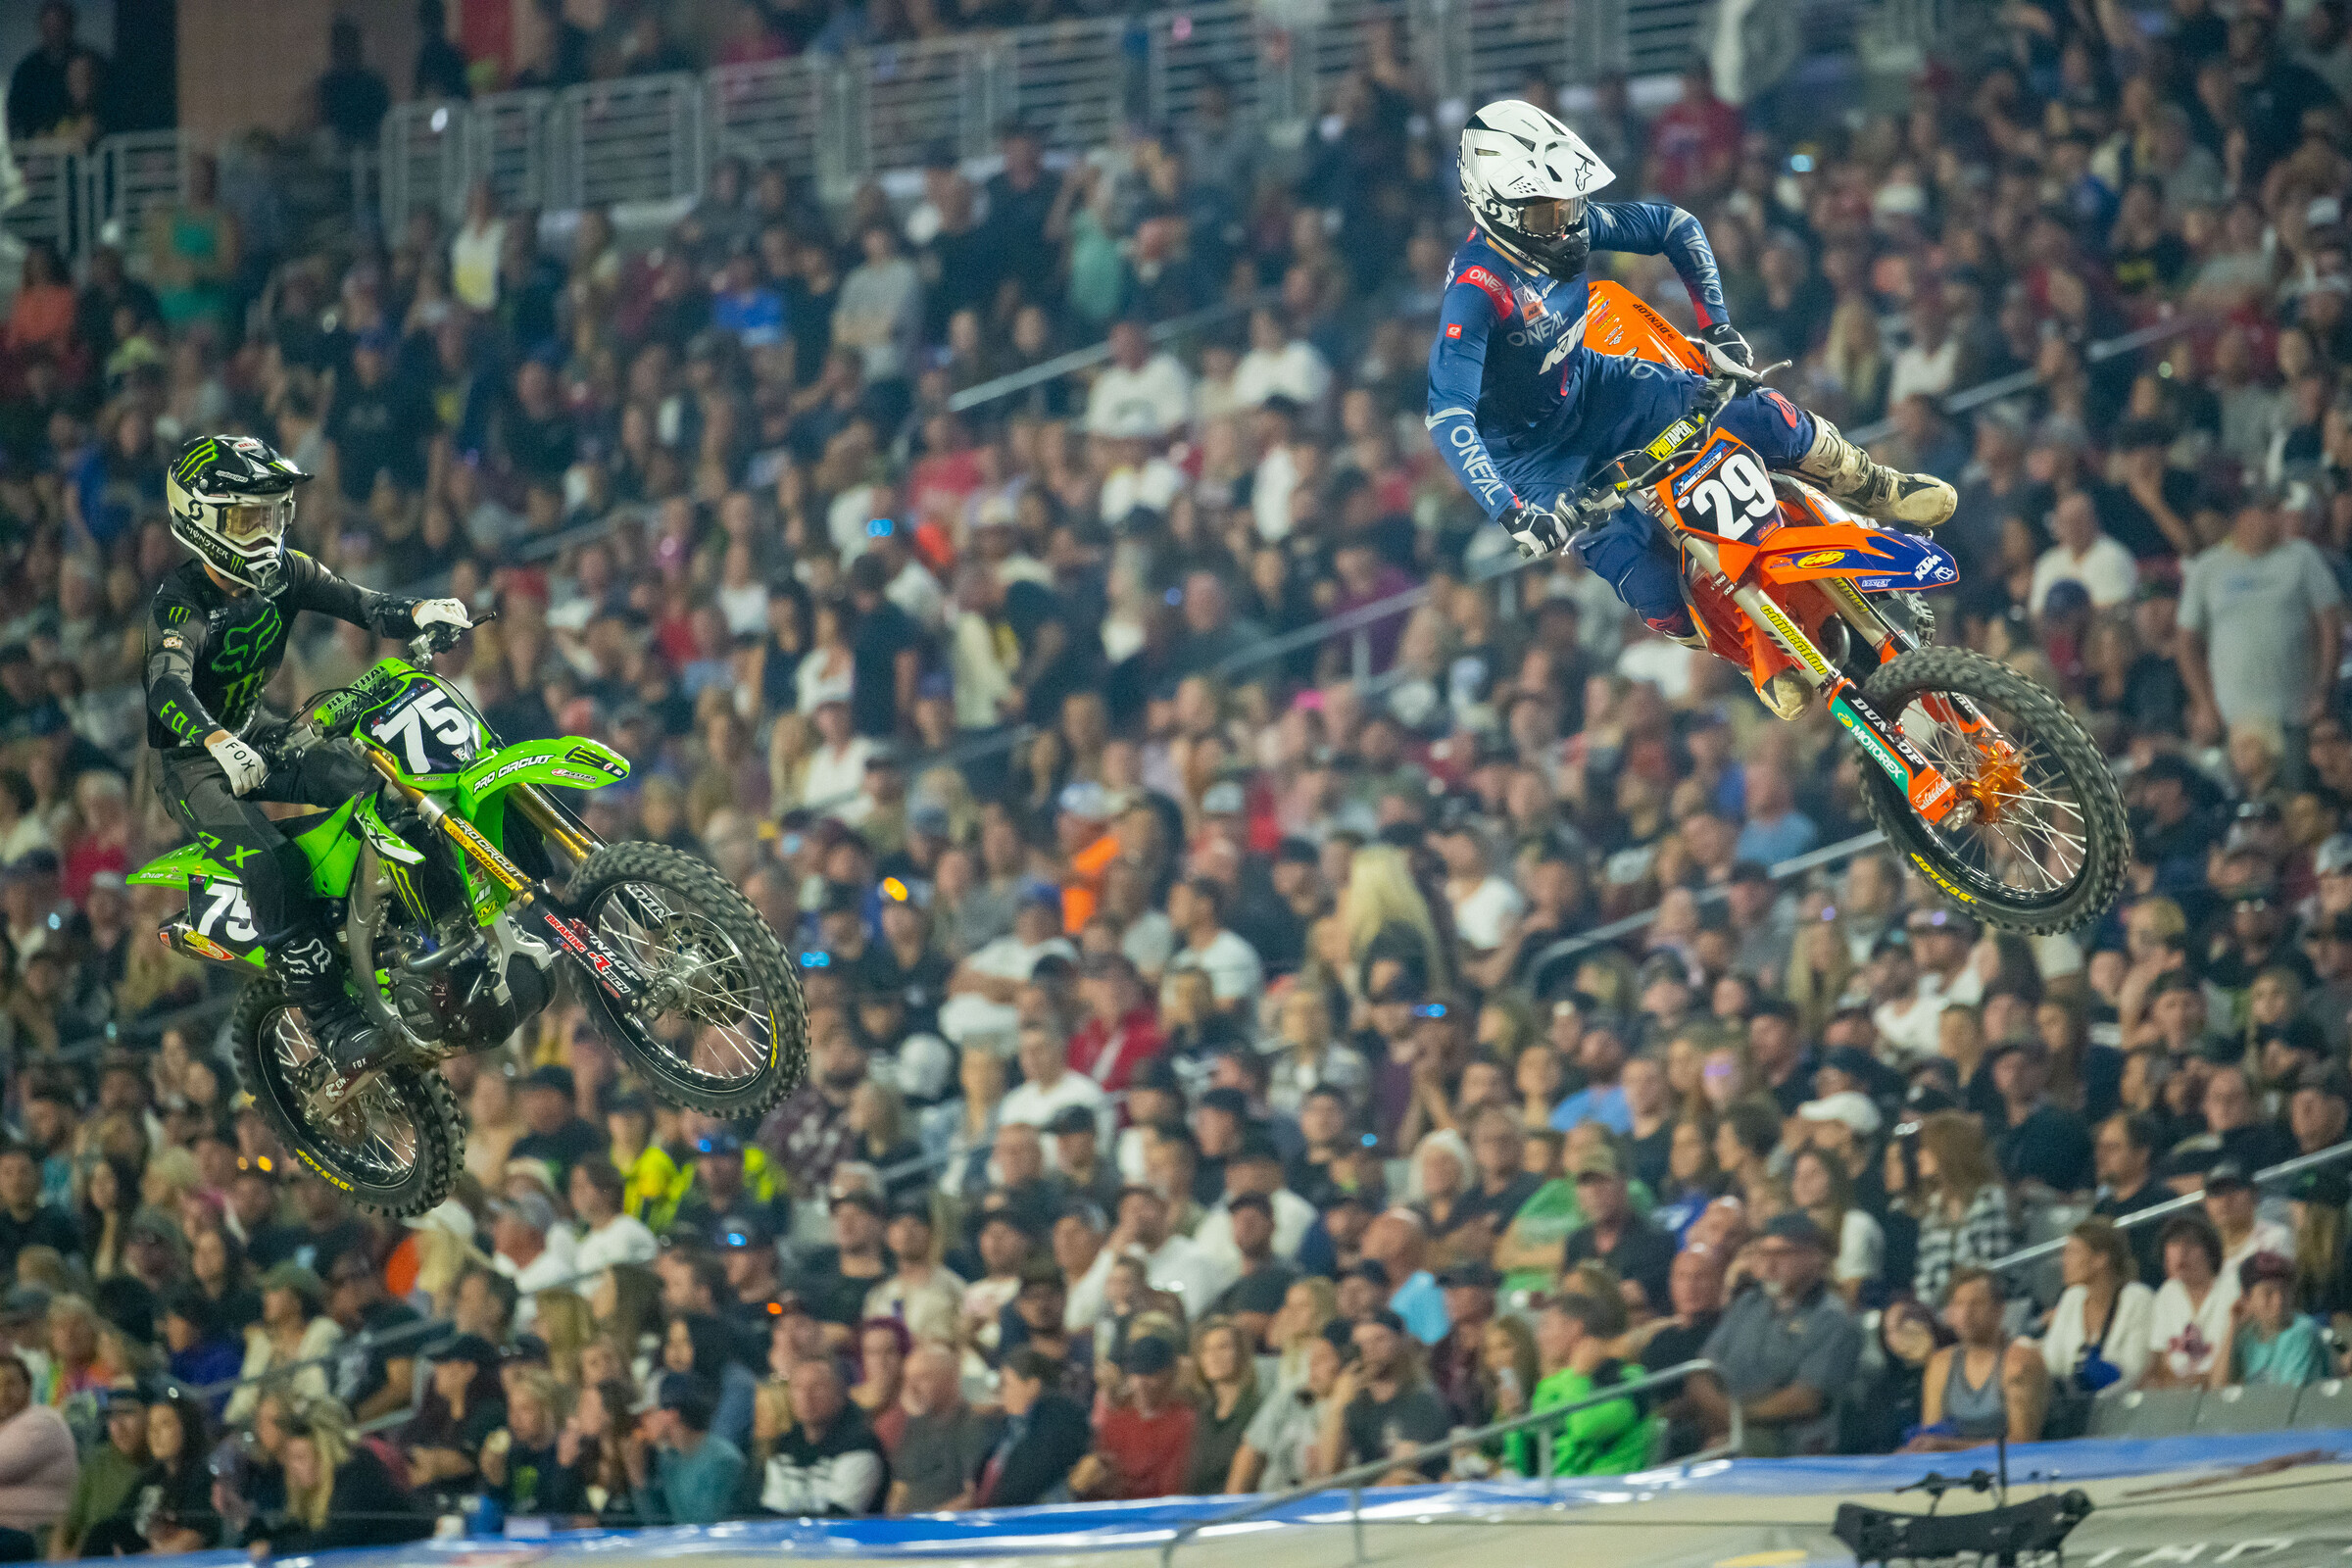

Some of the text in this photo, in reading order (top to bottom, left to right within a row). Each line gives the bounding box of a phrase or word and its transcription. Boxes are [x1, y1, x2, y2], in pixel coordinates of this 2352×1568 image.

[1633, 303, 1671, 335] DUNLOP
[1691, 454, 1777, 542] 29
[185, 523, 228, 560] MONSTER
[1797, 551, 1845, 569] FMF
[1862, 578, 1892, 588] VERTEX
[1914, 554, 1943, 581] KTM
[371, 688, 470, 774] 75
[225, 741, 256, 772] FOX
[1851, 724, 1904, 780] MOTOREX
[472, 770, 496, 796] PRO
[497, 754, 557, 780] CIRCUIT
[358, 810, 389, 850] KX
[452, 816, 525, 879] PRO CIRCUIT
[468, 846, 513, 885] SHOWA
[1911, 853, 1970, 905] DUNLOP
[196, 882, 260, 942] 75
[546, 914, 587, 954] BRAKING
[570, 951, 601, 980] PISTONS
[352, 1057, 367, 1070] FOX
[295, 1148, 352, 1192] DUNLOP
